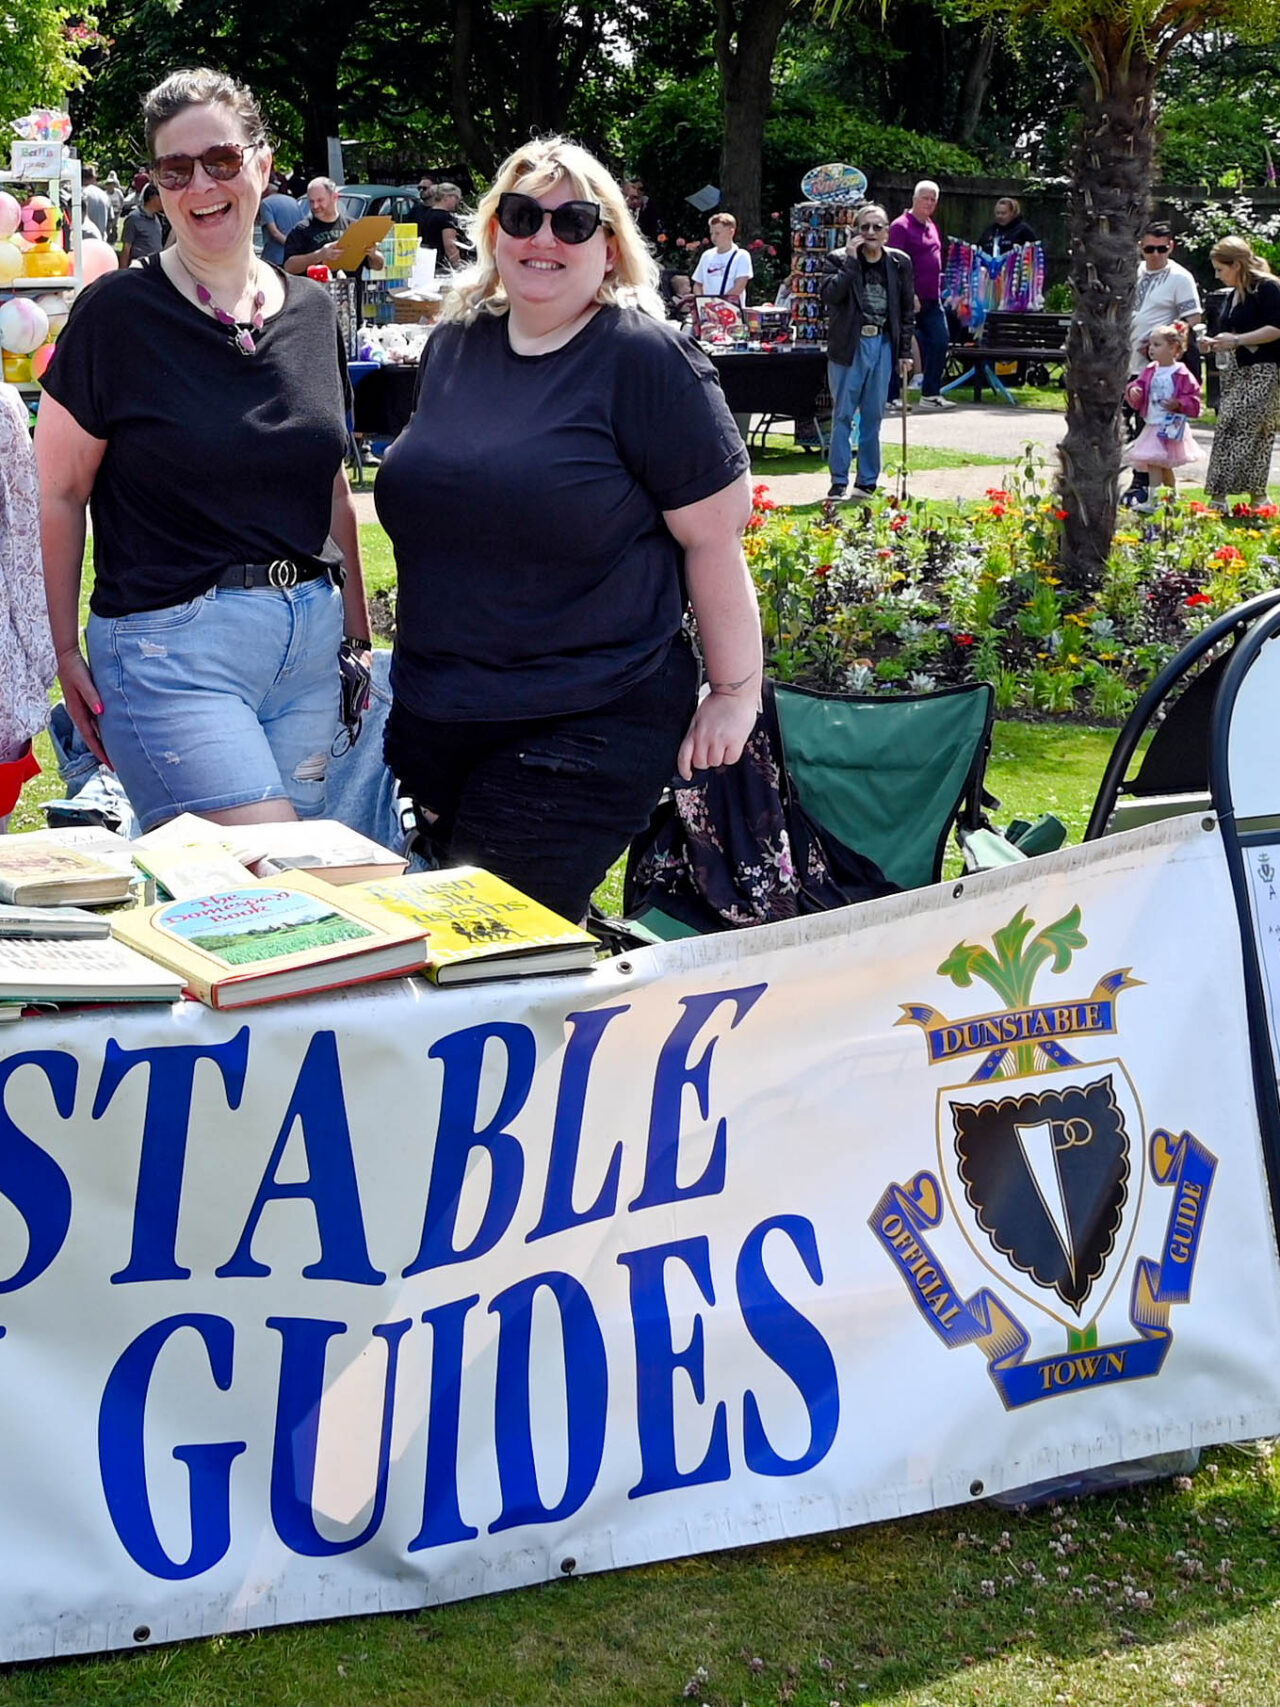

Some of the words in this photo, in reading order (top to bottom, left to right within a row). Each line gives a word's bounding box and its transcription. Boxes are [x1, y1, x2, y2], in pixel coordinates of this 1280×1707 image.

[161, 891, 291, 924] Domesday
[191, 894, 239, 907] The
[210, 904, 271, 922] Book
[938, 1003, 1103, 1056] DUNSTABLE
[1168, 1180, 1204, 1264] GUIDE
[881, 1214, 960, 1332] OFFICIAL
[1038, 1350, 1126, 1391] TOWN
[98, 1214, 840, 1580] GUIDES
